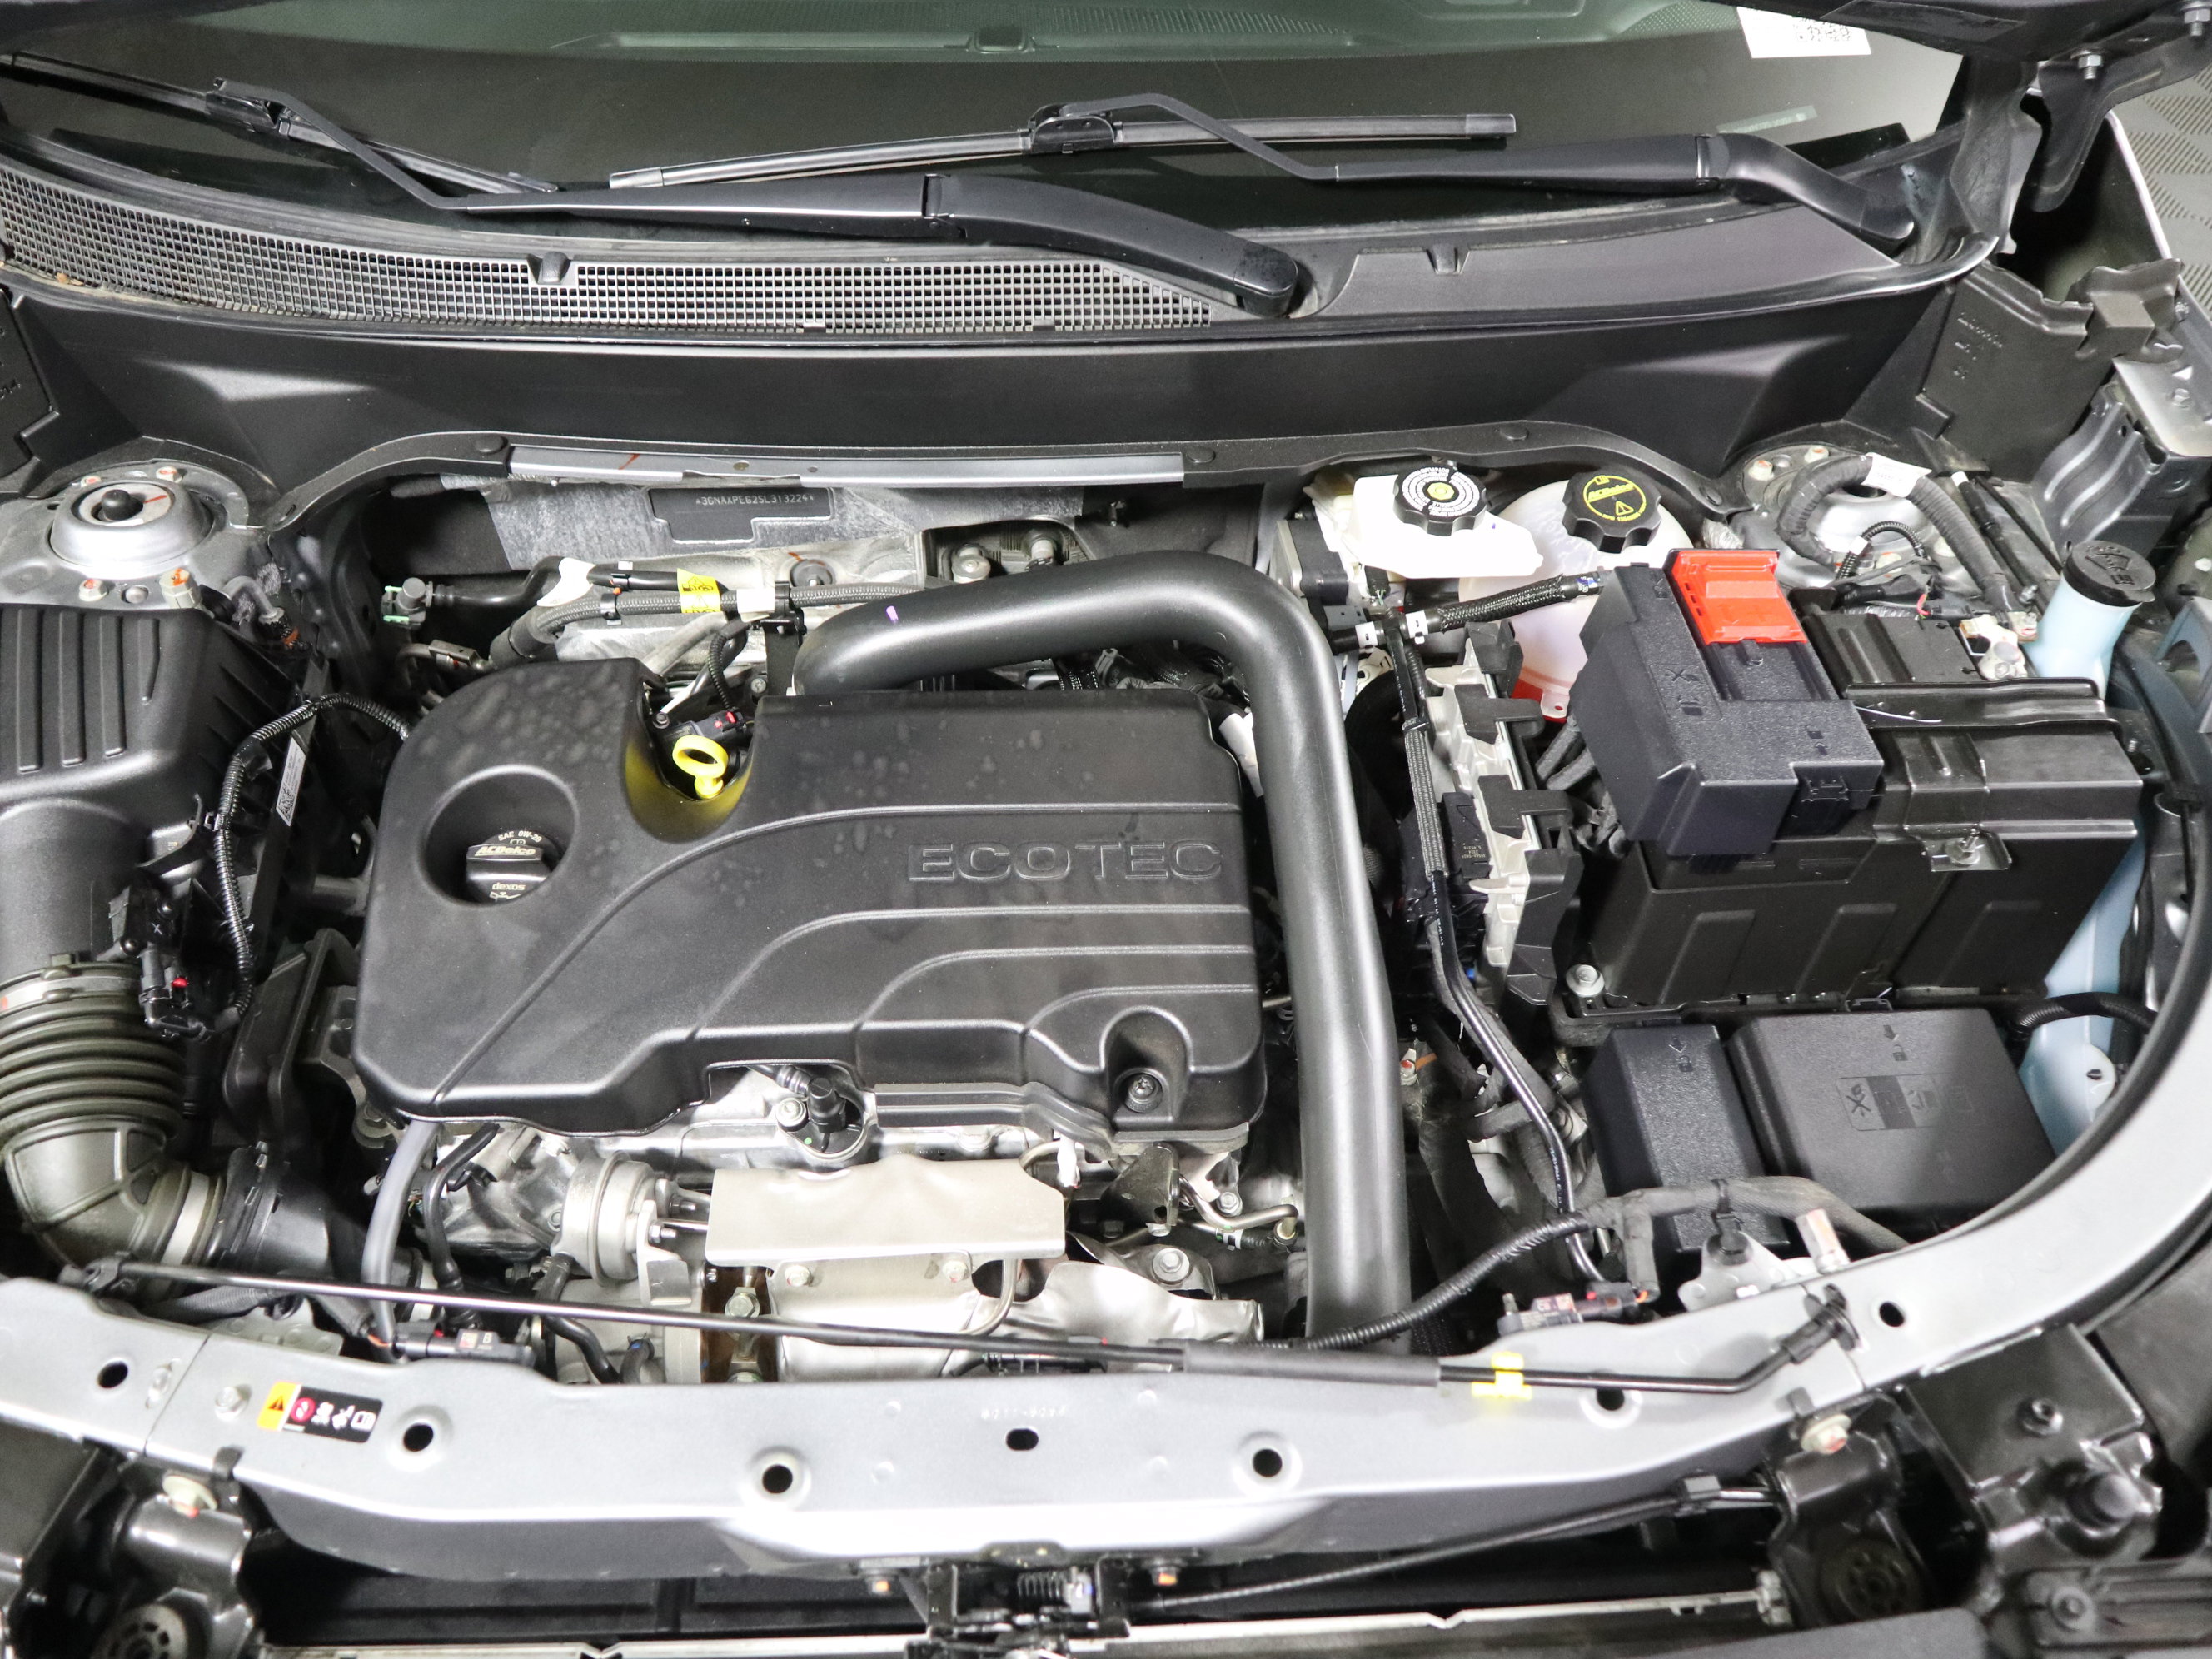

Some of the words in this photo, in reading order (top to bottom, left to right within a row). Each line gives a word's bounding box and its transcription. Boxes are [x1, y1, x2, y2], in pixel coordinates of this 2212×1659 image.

[498, 831, 515, 841] SAE
[518, 830, 542, 843] 0W-20
[474, 845, 536, 857] ACDelco
[908, 839, 1223, 881] ECOTEC
[491, 882, 526, 891] dexos
